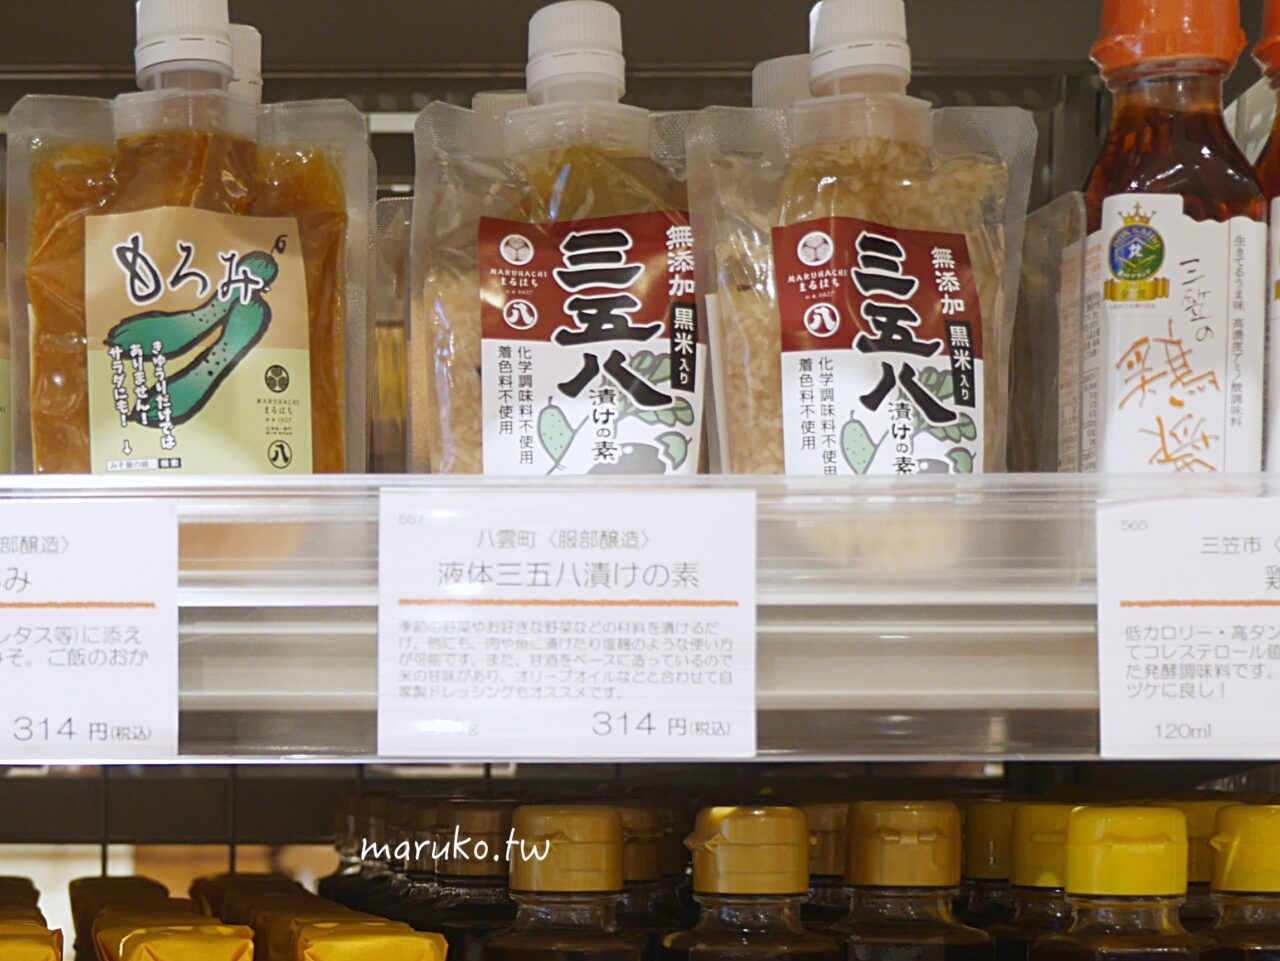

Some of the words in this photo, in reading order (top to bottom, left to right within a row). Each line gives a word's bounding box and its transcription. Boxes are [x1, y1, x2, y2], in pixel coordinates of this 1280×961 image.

[115, 234, 263, 306] もろみ
[666, 224, 696, 297] 無添加
[931, 246, 965, 316] 無添加
[673, 306, 694, 385] 黒米入り
[949, 325, 972, 401] 黒米入り
[498, 346, 513, 435] 着色料不使用
[518, 346, 533, 465] 化学調味料不使用
[589, 388, 617, 462] 漬けの素
[799, 358, 816, 451] 着色料不使用
[438, 561, 700, 588] 液体三五八漬けの素
[13, 716, 77, 741] 314
[592, 711, 656, 736] 314
[1154, 723, 1212, 739] 120ml
